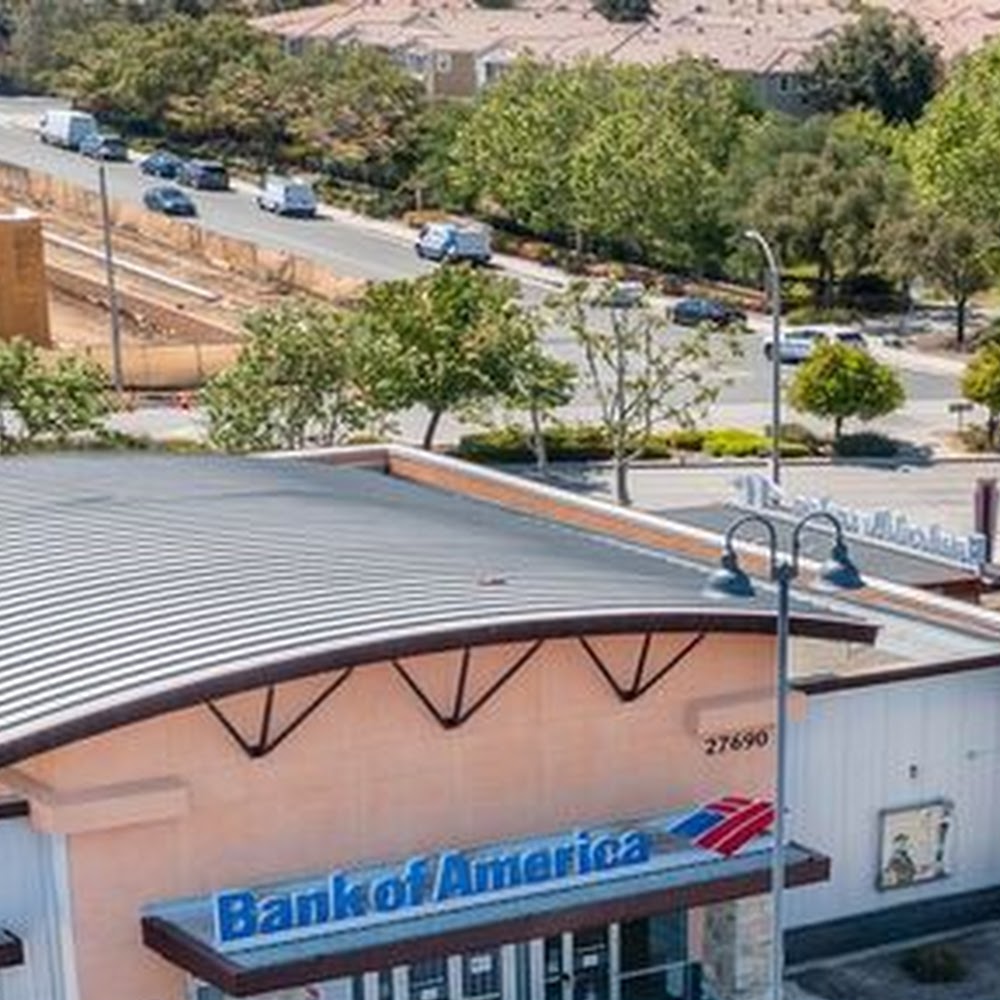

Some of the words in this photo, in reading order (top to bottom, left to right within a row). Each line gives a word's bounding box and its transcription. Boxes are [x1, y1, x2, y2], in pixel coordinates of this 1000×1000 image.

[704, 729, 768, 755] 27690
[215, 870, 367, 942] Bank
[371, 856, 427, 912] of
[433, 829, 649, 900] America
